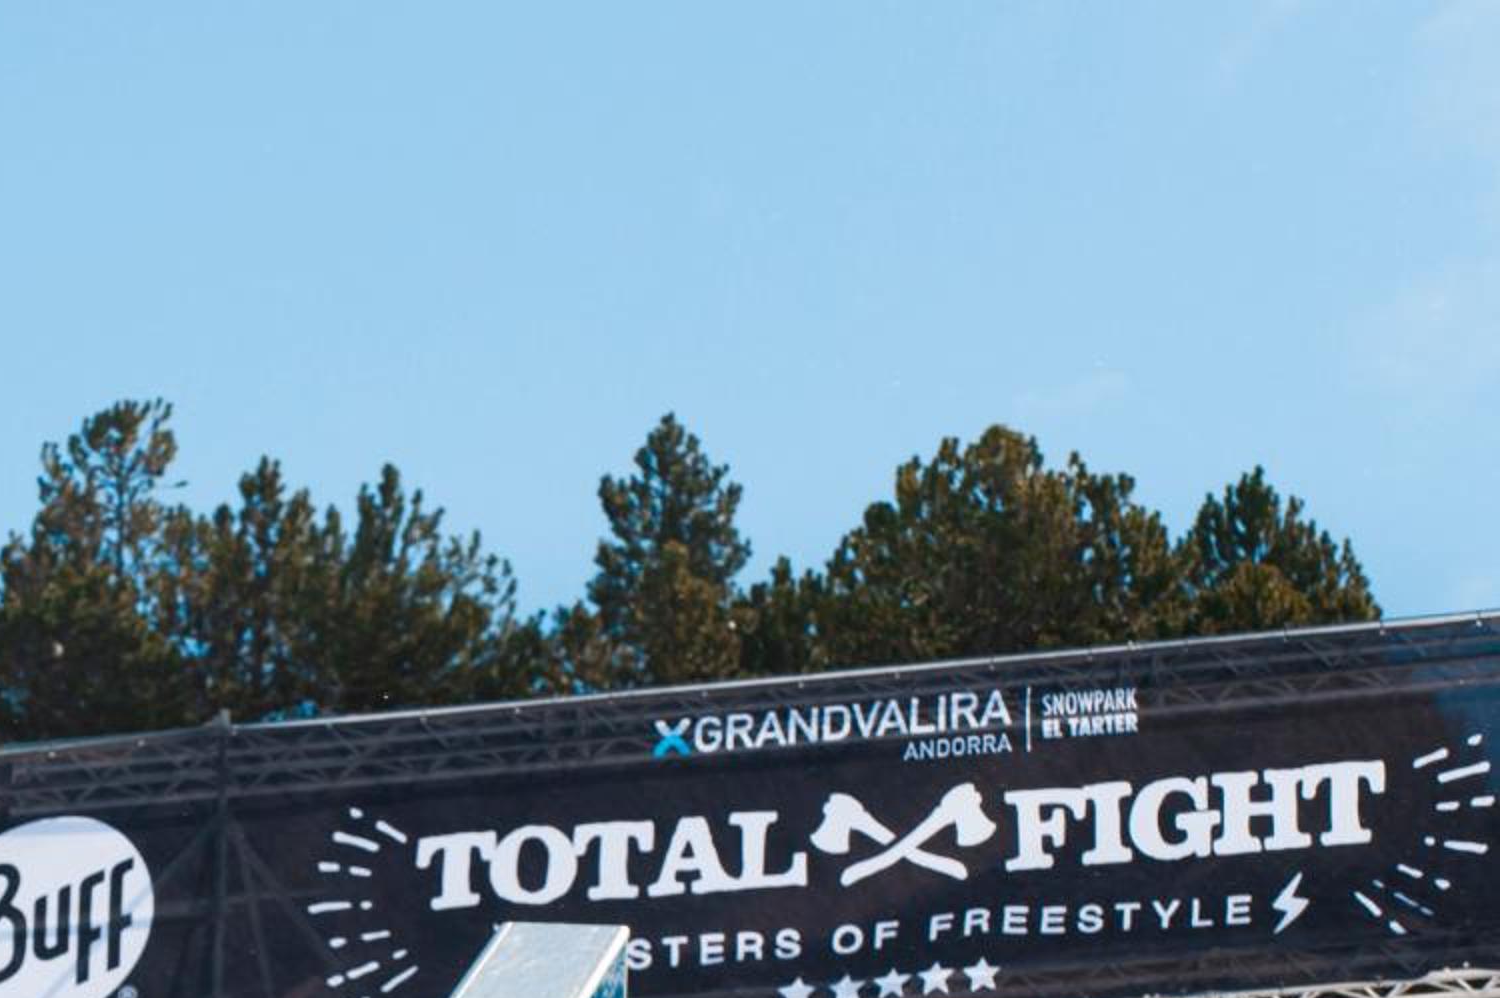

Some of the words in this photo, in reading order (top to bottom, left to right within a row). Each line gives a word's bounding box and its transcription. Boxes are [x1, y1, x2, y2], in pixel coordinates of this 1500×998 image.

[694, 688, 1013, 753] GRANDVALIRA
[1042, 687, 1138, 717] SNOWPARK
[1042, 718, 1063, 738] EL
[1067, 712, 1139, 737] TARTER
[902, 735, 1013, 761] ANDORRA
[416, 811, 808, 911] TOTAL
[1003, 759, 1386, 872] FIGHT
[627, 928, 801, 970] STERS
[832, 921, 899, 954] OF
[929, 895, 1252, 941] FREESTYLE
